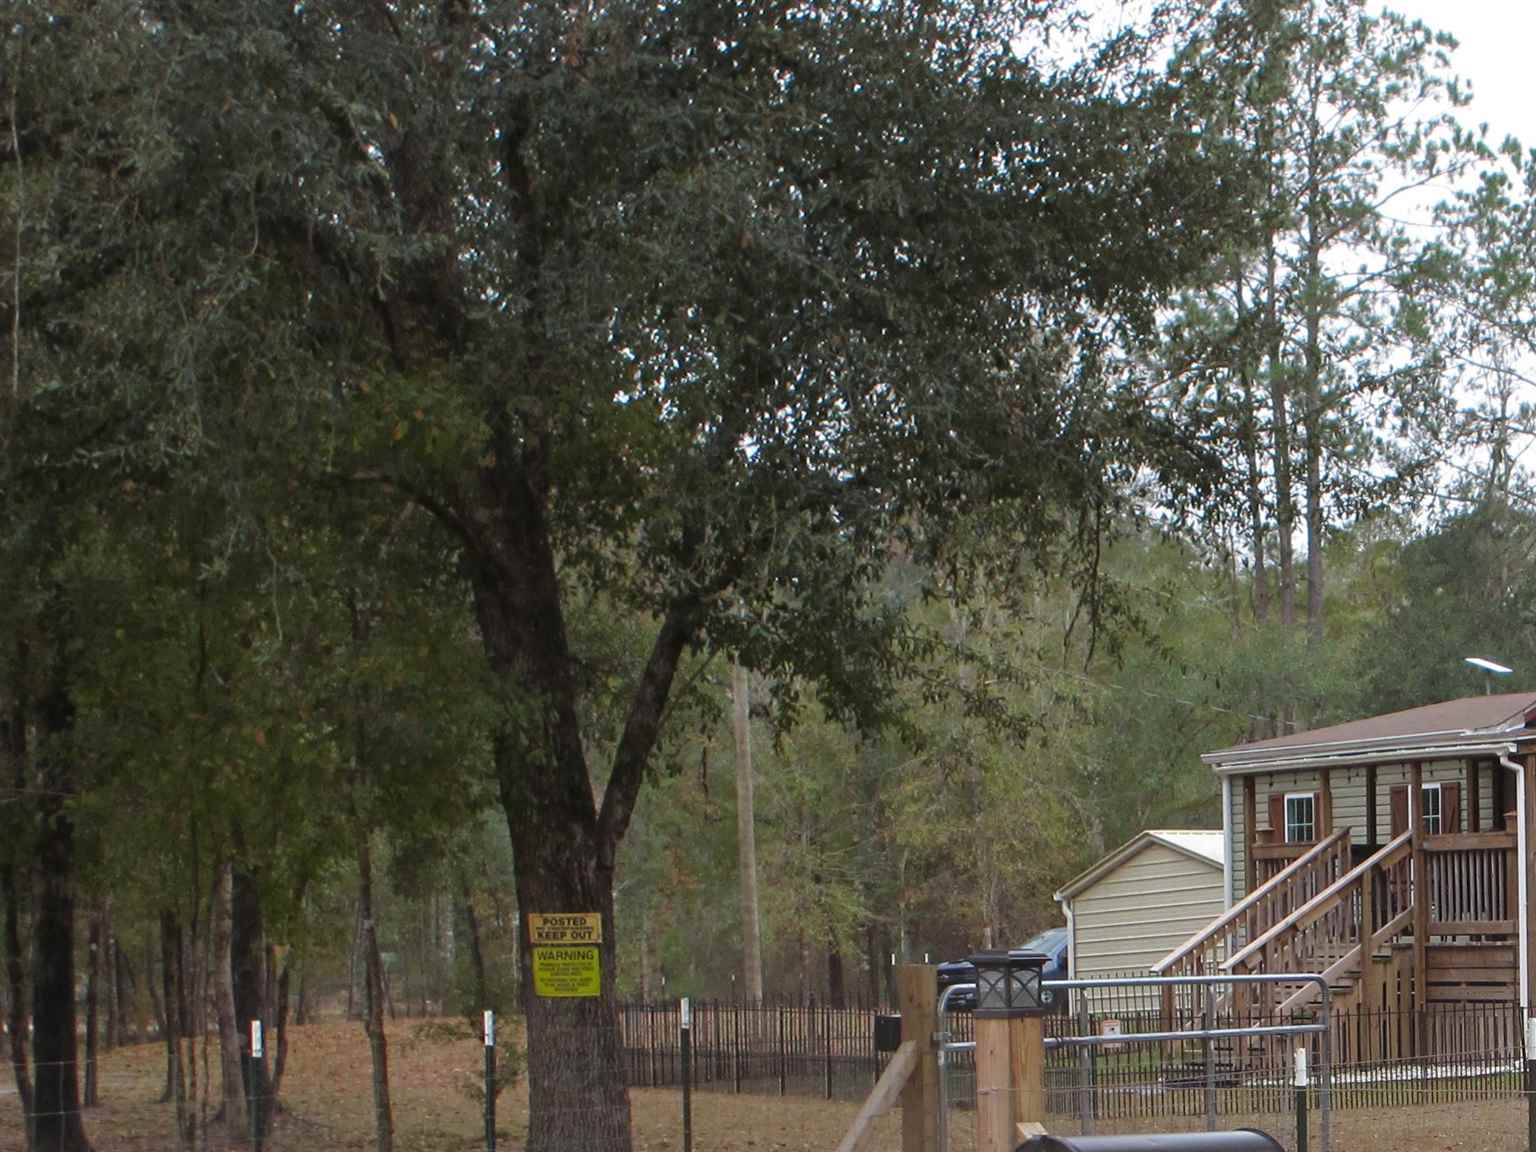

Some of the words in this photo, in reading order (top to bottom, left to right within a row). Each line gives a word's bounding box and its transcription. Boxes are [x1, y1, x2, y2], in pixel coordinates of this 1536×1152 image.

[543, 917, 586, 925] POSTED
[537, 931, 567, 939] KEEP
[571, 931, 592, 939] OUT
[537, 950, 594, 961] WARNING
